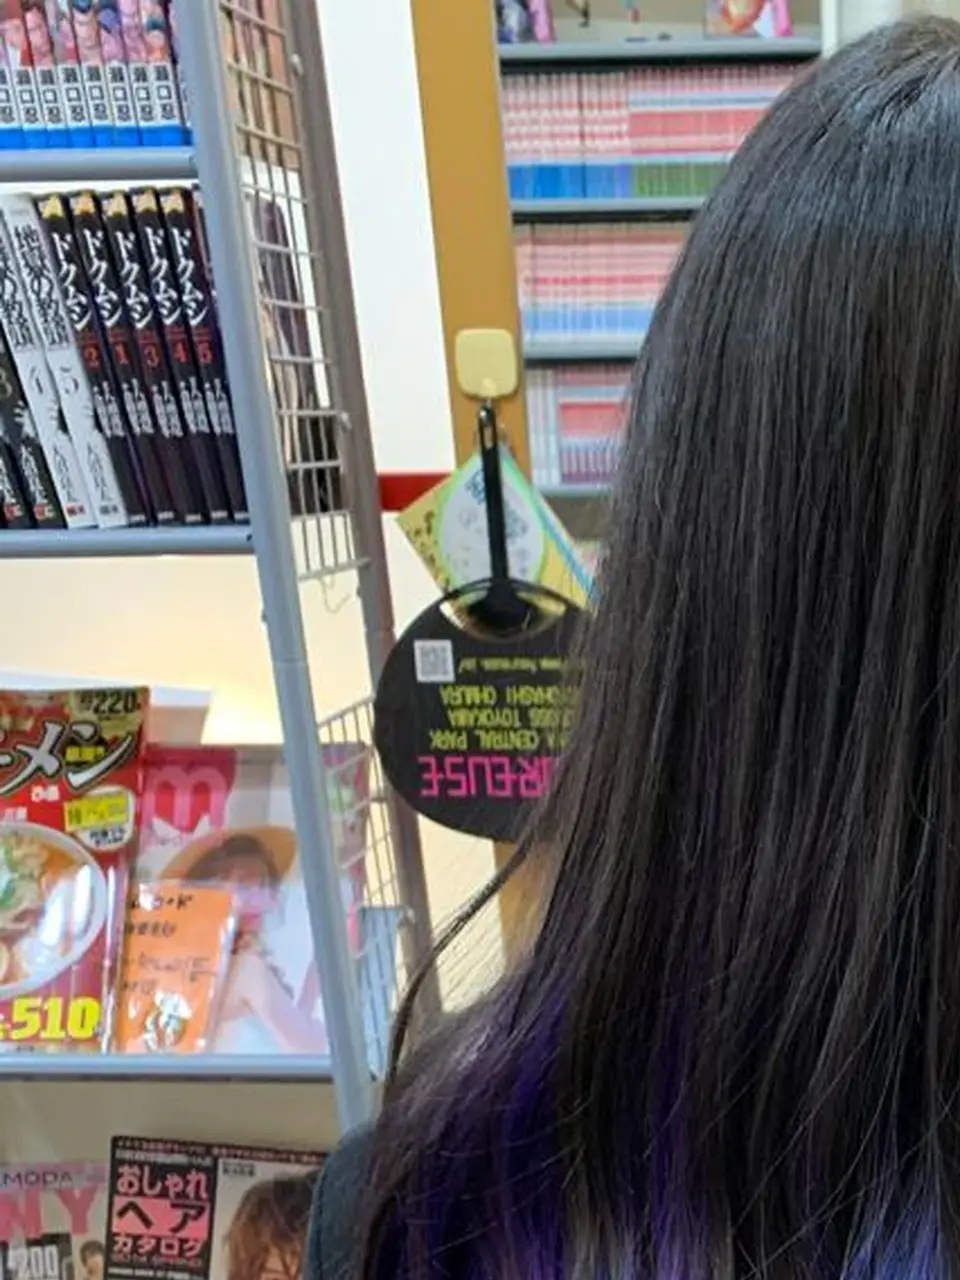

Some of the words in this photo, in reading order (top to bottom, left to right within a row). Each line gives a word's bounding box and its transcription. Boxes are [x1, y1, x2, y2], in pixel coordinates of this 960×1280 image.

[52, 232, 92, 331] ドクムシ
[83, 228, 122, 327] ドクムシ
[115, 230, 153, 330] ドクムシ
[145, 227, 182, 325] ドクムシ
[171, 227, 208, 326] ドクムシ
[0, 721, 133, 794] メン
[429, 729, 467, 750] PARK
[116, 1164, 208, 1200] おしゃれ
[116, 1200, 206, 1233] ヘア
[113, 1236, 203, 1257] カタログ
